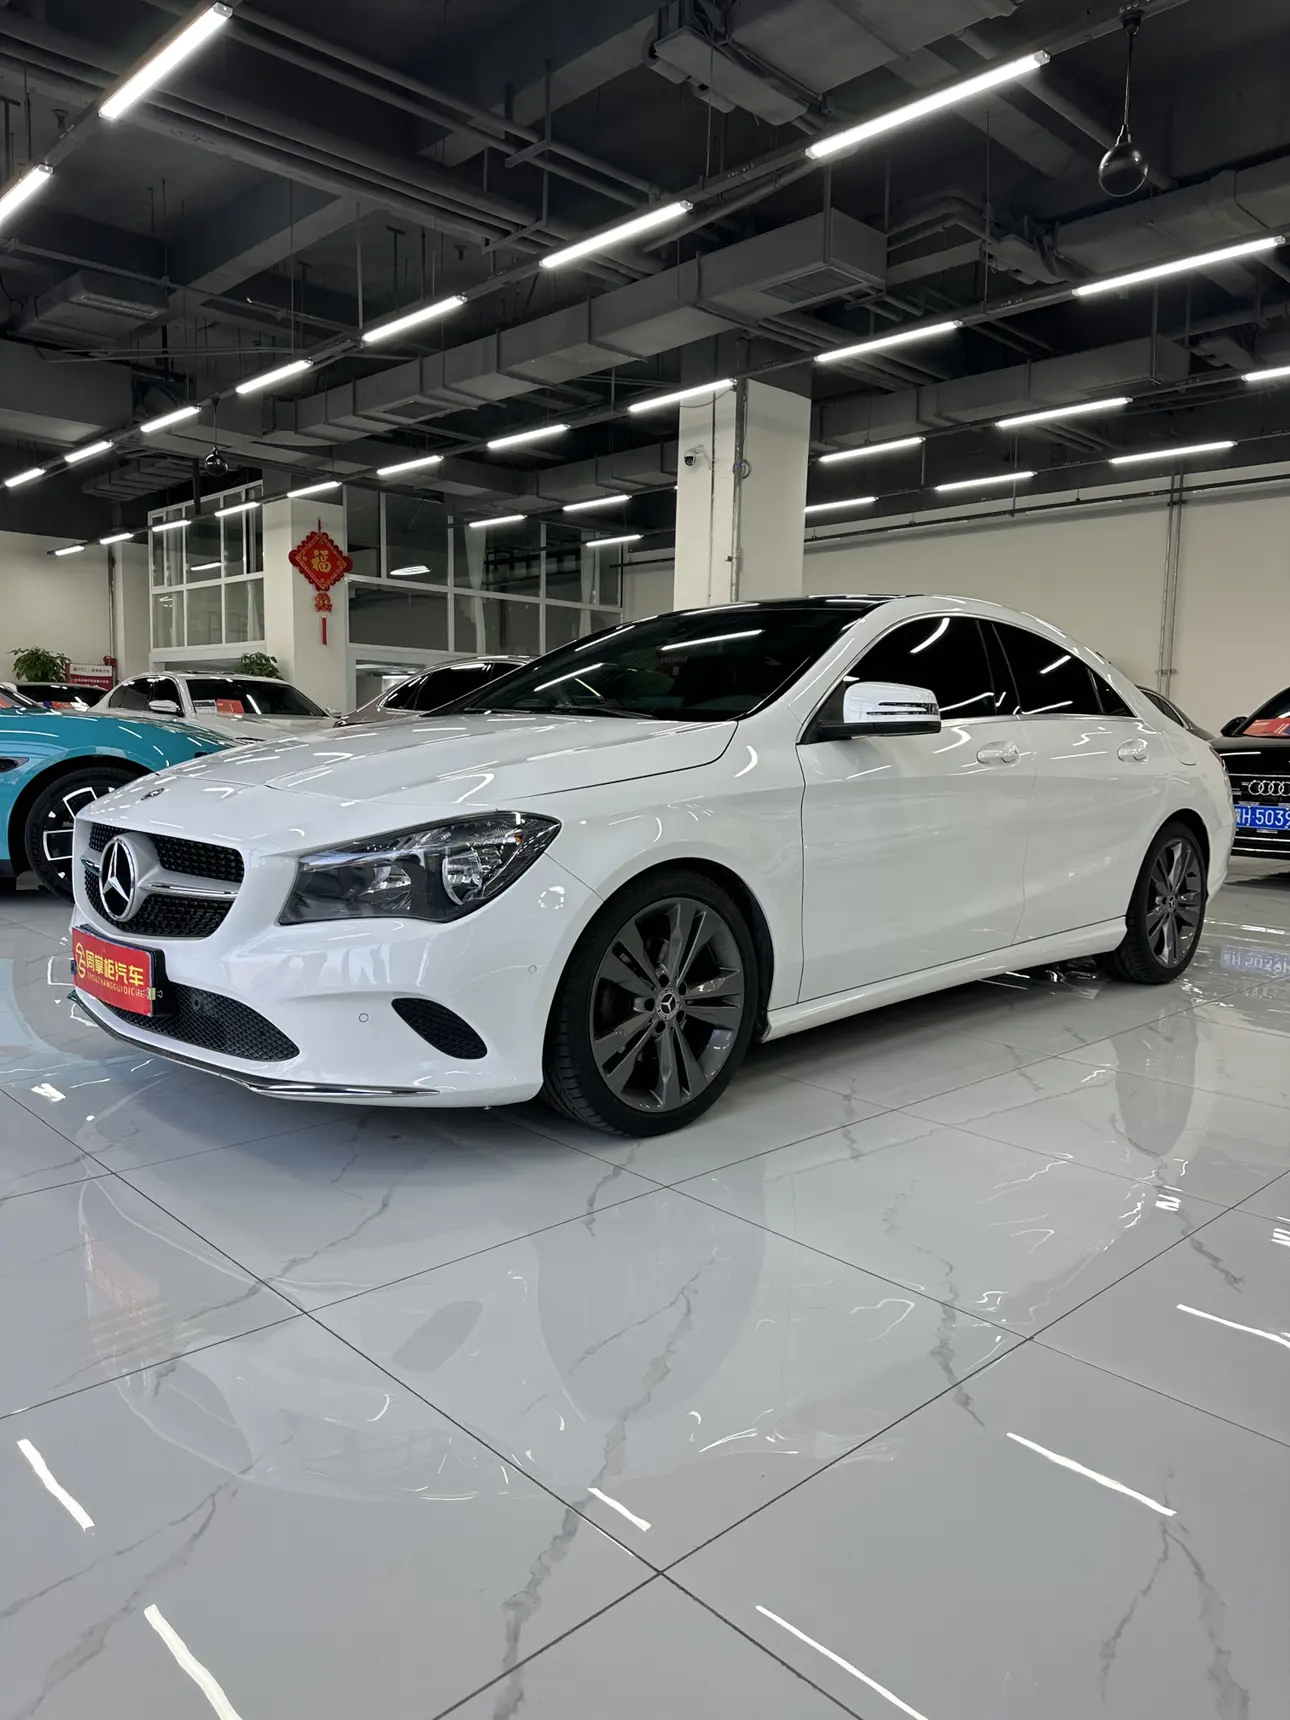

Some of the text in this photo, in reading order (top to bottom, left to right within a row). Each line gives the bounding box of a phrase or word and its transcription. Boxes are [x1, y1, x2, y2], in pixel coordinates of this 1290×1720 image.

[311, 549, 331, 572] 福
[86, 950, 144, 986] 周掌柜汽车
